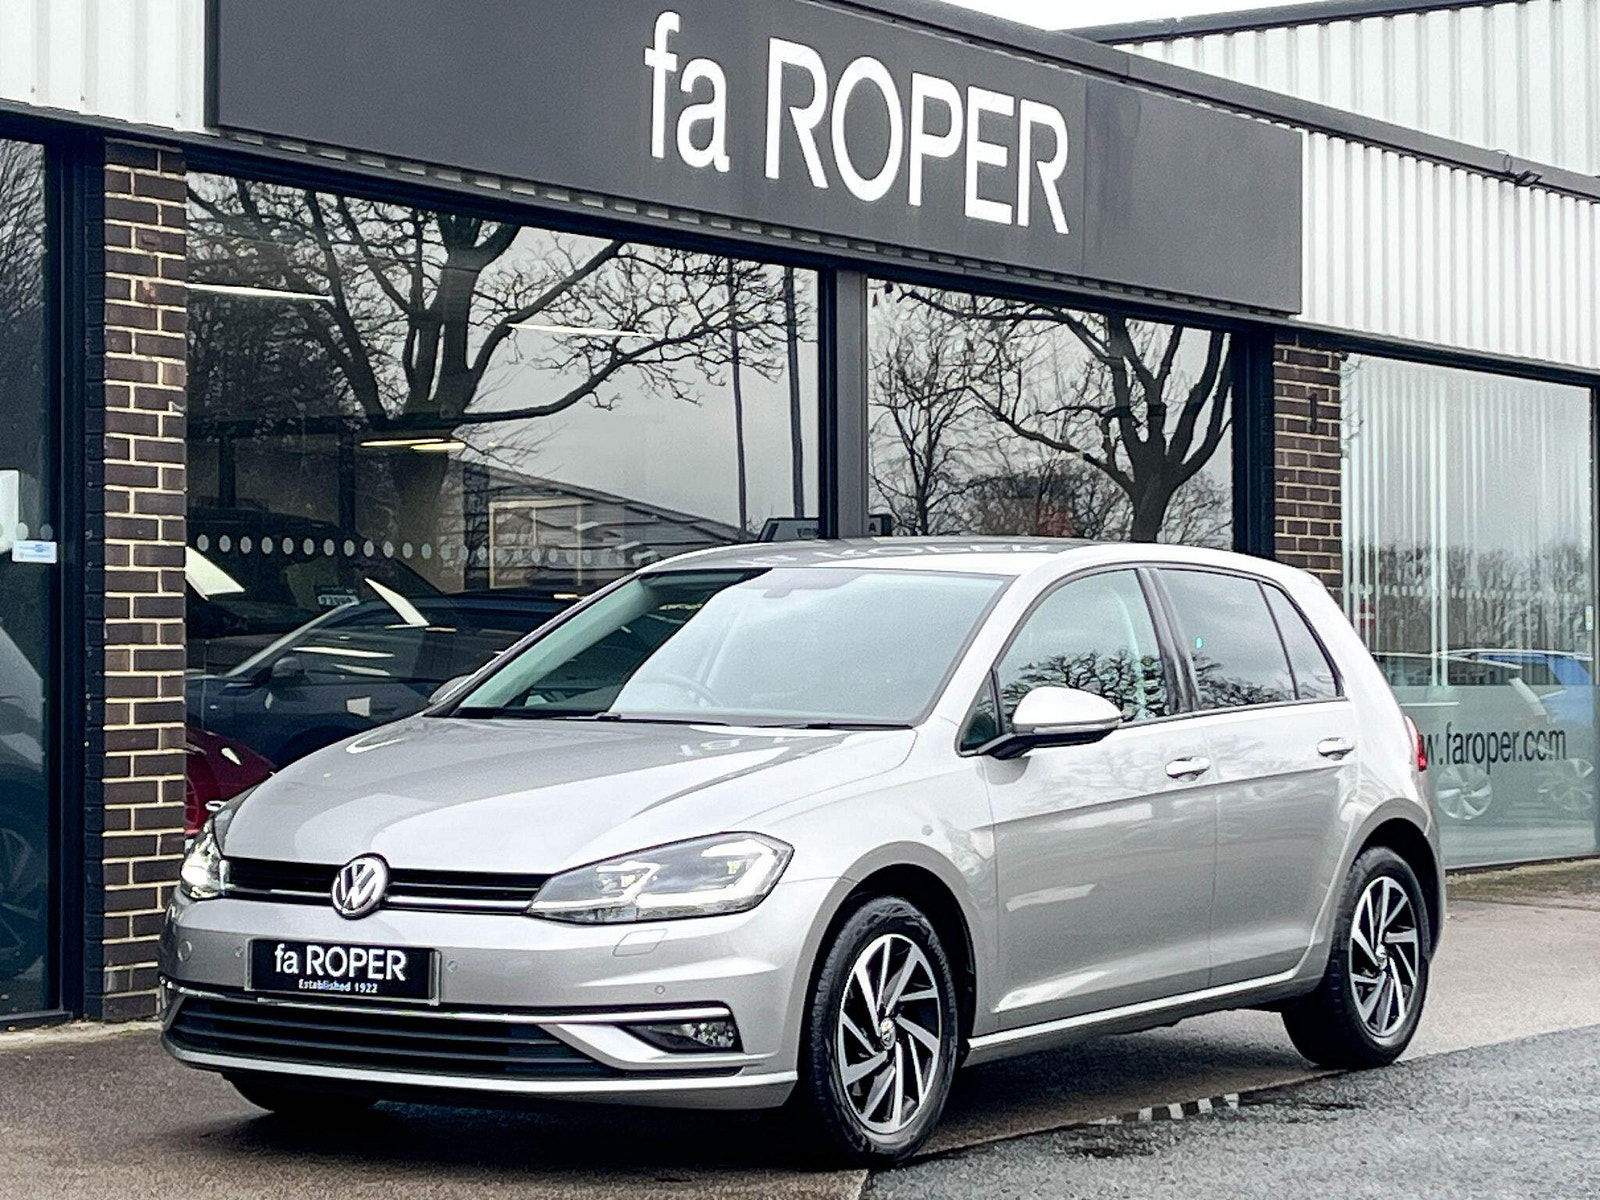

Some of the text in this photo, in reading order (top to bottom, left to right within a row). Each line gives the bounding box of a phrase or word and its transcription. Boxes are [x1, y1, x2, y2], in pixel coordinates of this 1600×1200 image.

[644, 11, 1070, 235] fa ROPER
[274, 943, 408, 982] fa ROPER
[298, 978, 378, 994] Established 1922
